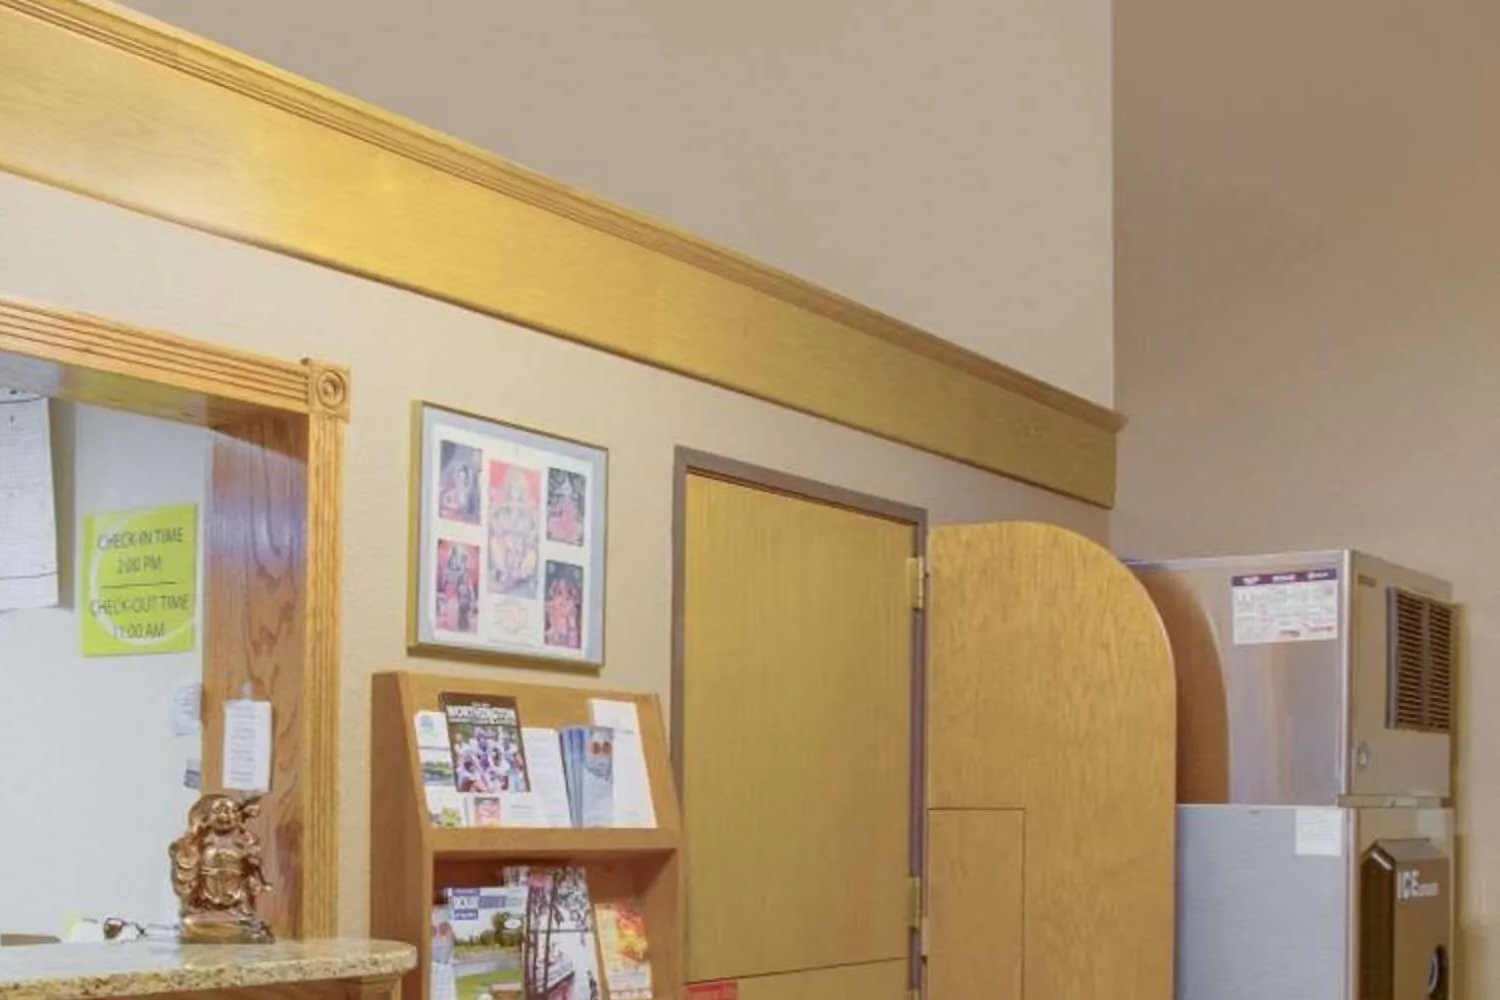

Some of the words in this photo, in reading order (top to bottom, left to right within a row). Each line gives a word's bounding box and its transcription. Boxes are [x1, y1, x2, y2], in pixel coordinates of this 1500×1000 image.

[155, 526, 184, 545] TIME
[143, 553, 163, 573] PM
[158, 593, 190, 612] TIME
[143, 621, 166, 638] AM
